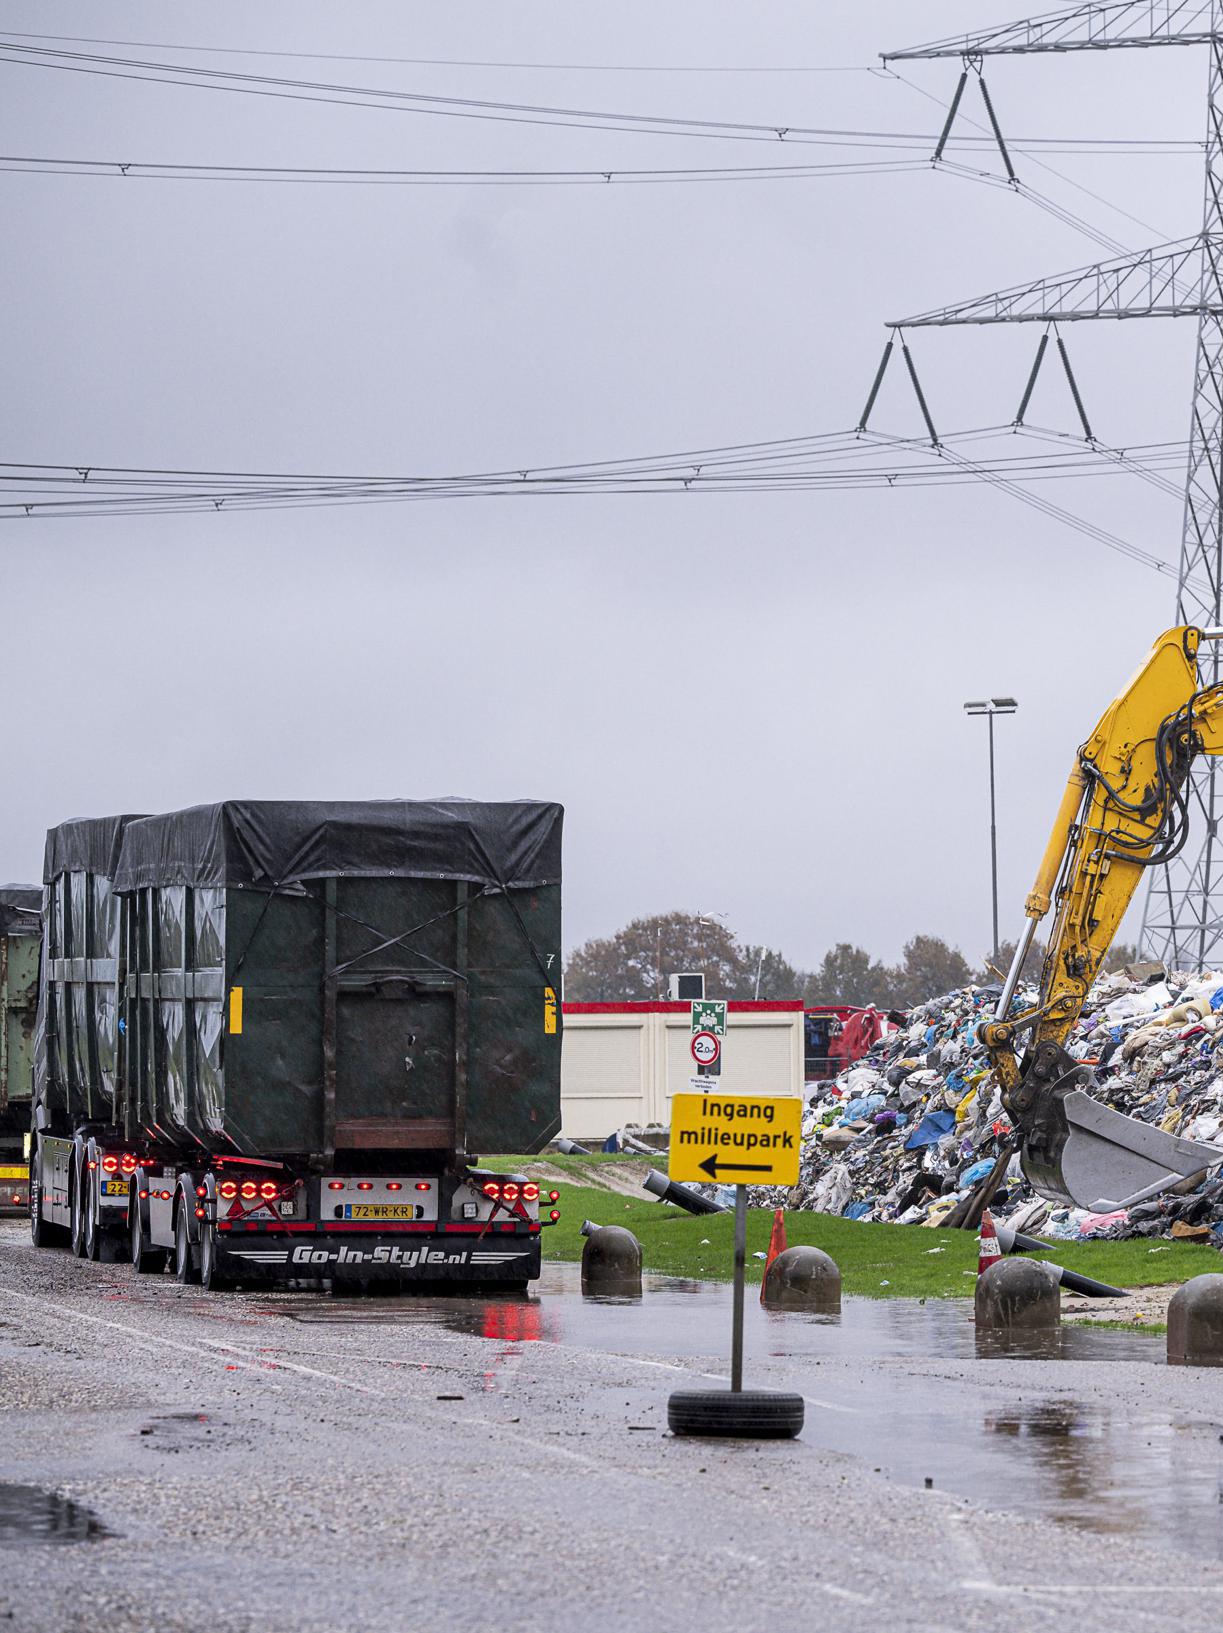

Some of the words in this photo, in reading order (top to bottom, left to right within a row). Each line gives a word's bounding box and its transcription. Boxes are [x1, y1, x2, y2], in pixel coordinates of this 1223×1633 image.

[702, 1098, 775, 1123] Ingang
[680, 1127, 793, 1151] milieupark
[354, 1206, 409, 1217] 72-WR-KR
[292, 1246, 467, 1268] Go-In-Style.nl
